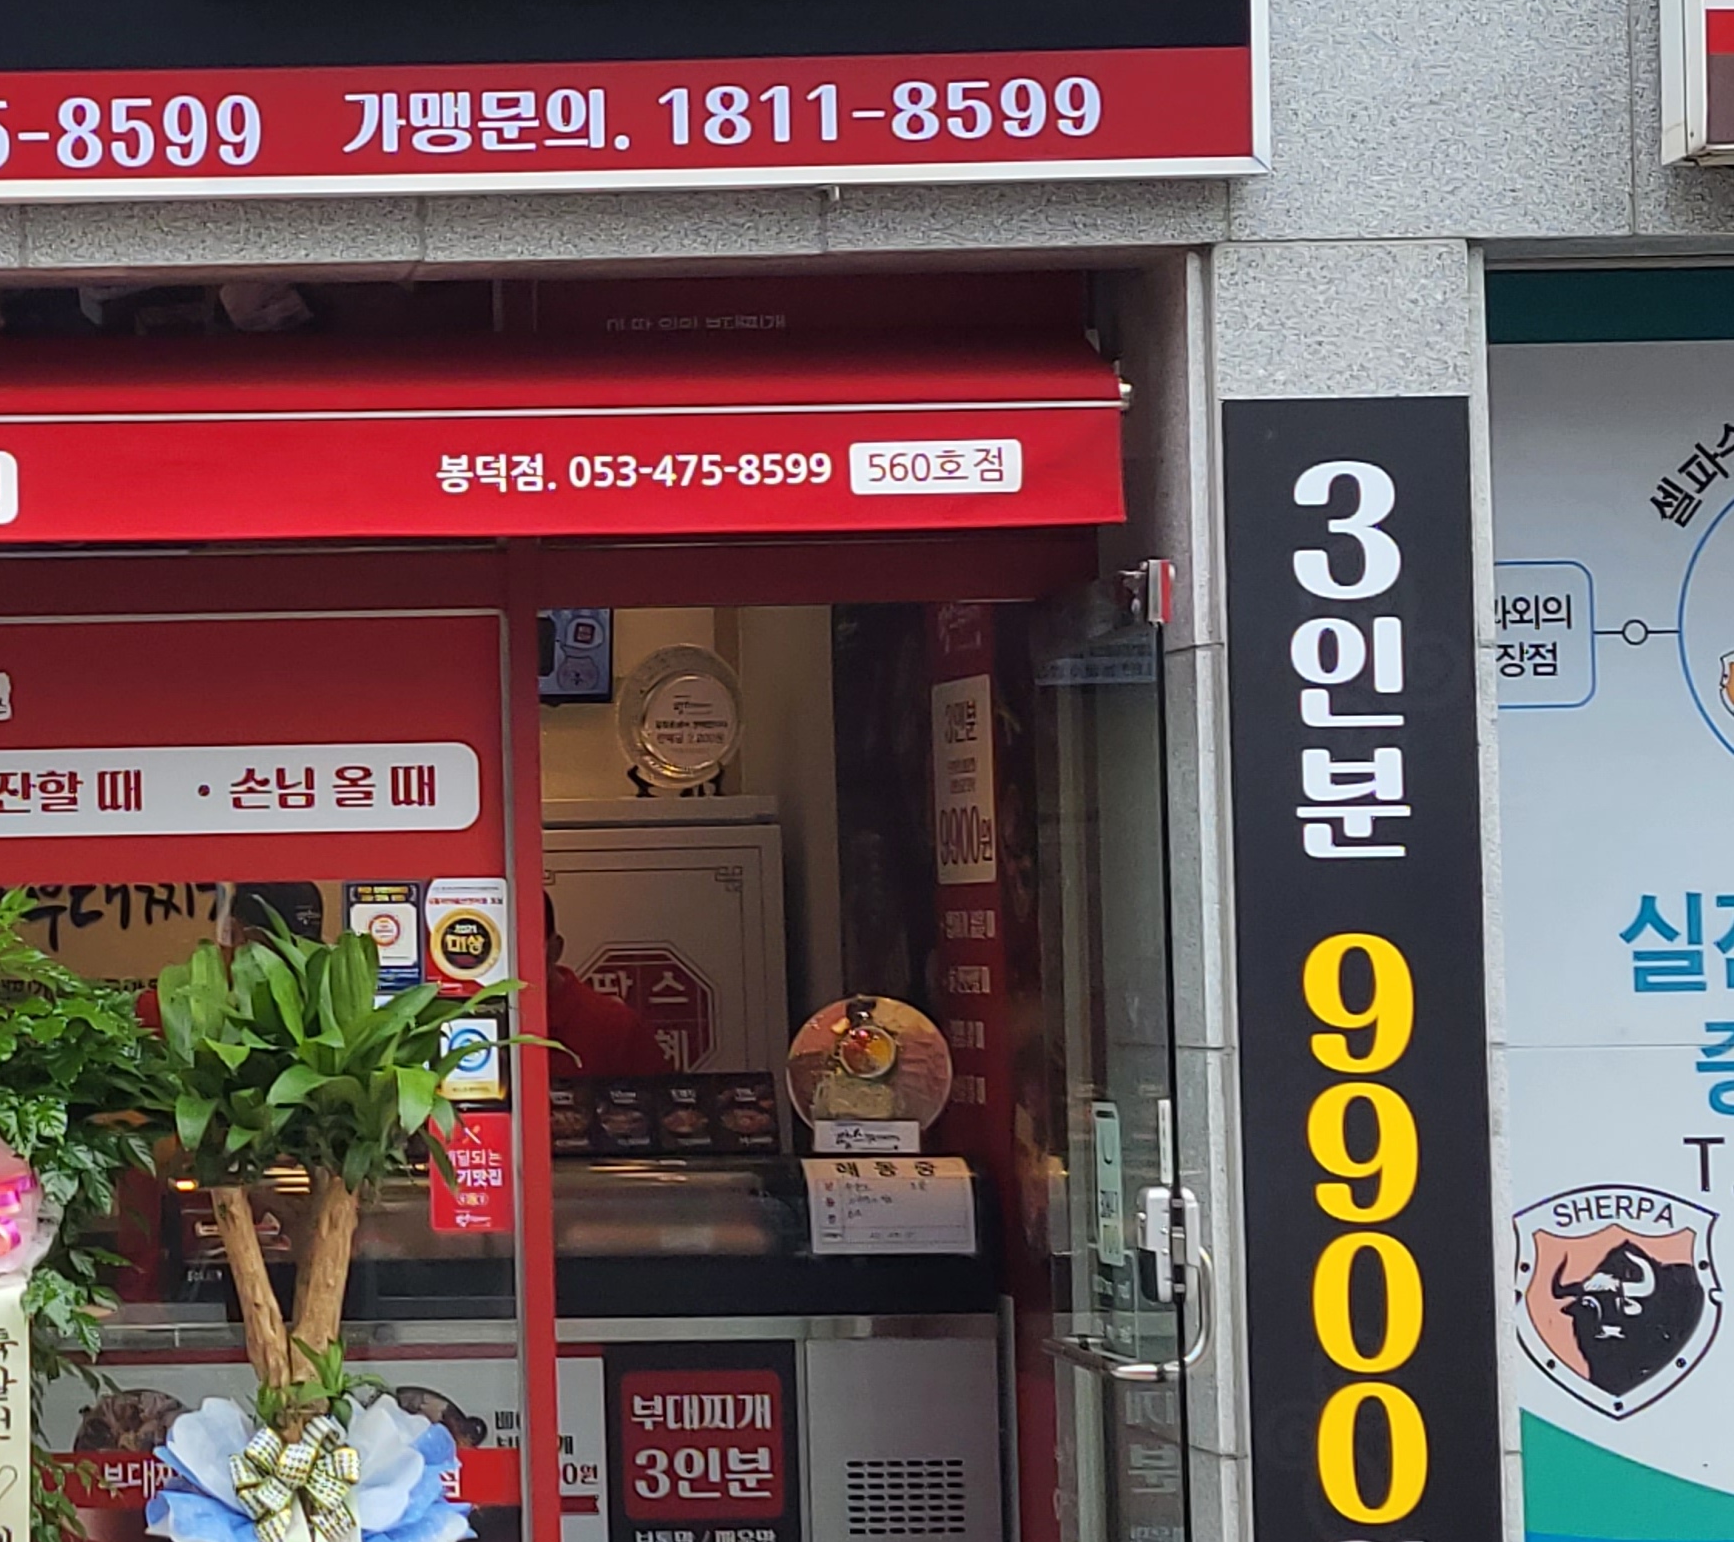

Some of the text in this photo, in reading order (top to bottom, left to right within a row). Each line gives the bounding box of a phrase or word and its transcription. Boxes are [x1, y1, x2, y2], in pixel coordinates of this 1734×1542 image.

[342, 87, 629, 157] 가맹문의.
[659, 76, 1103, 145] 1811-8599
[435, 447, 1006, 494] 봉덕점. 053-475-8599 560호점
[1650, 422, 1734, 528] 셀파
[1289, 460, 1411, 858] 3인분
[97, 769, 143, 813] 때
[228, 764, 317, 811] 손님
[330, 763, 378, 809] 올
[390, 763, 437, 808] 때
[454, 1168, 503, 1187] 기맛집
[1552, 1194, 1675, 1229] SHERPA
[631, 1394, 773, 1431] 부대찌개
[633, 1447, 773, 1500] 3인분
